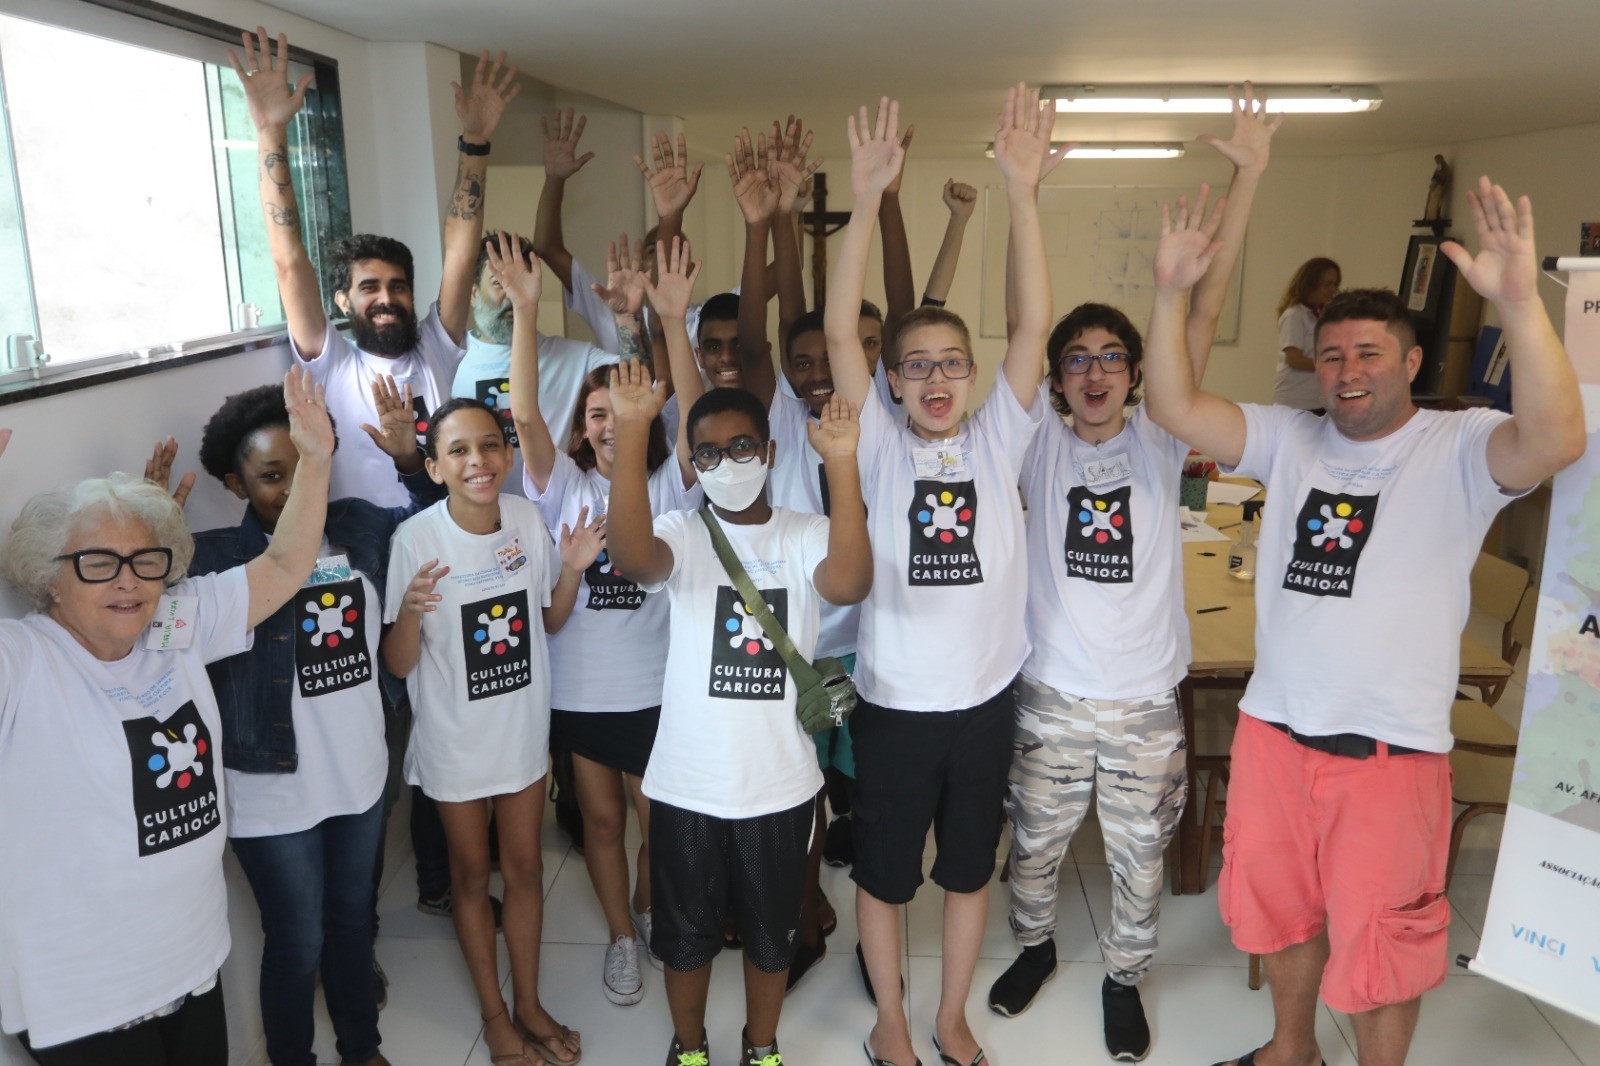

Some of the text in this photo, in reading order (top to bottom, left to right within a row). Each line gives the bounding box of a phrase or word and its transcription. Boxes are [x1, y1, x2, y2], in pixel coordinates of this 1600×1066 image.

[912, 553, 976, 565] CULTURA
[1067, 550, 1129, 565] CULTURA
[912, 567, 979, 580] CARIOCA
[1069, 563, 1130, 579] CARIOCA
[1291, 560, 1352, 577] CULTURA
[1287, 572, 1349, 591] CARIOCA
[302, 651, 367, 677] CULTURA
[470, 658, 528, 682] CULTURA
[714, 664, 783, 679] CULTURA
[304, 666, 370, 691] CARIOCA
[472, 672, 529, 695] CARIOCA
[712, 680, 782, 694] CARIOCA
[1555, 781, 1600, 803] AV. AF
[143, 791, 216, 828] CULTURA
[145, 808, 218, 846] CARIOCA
[1511, 923, 1566, 956] VINCI
